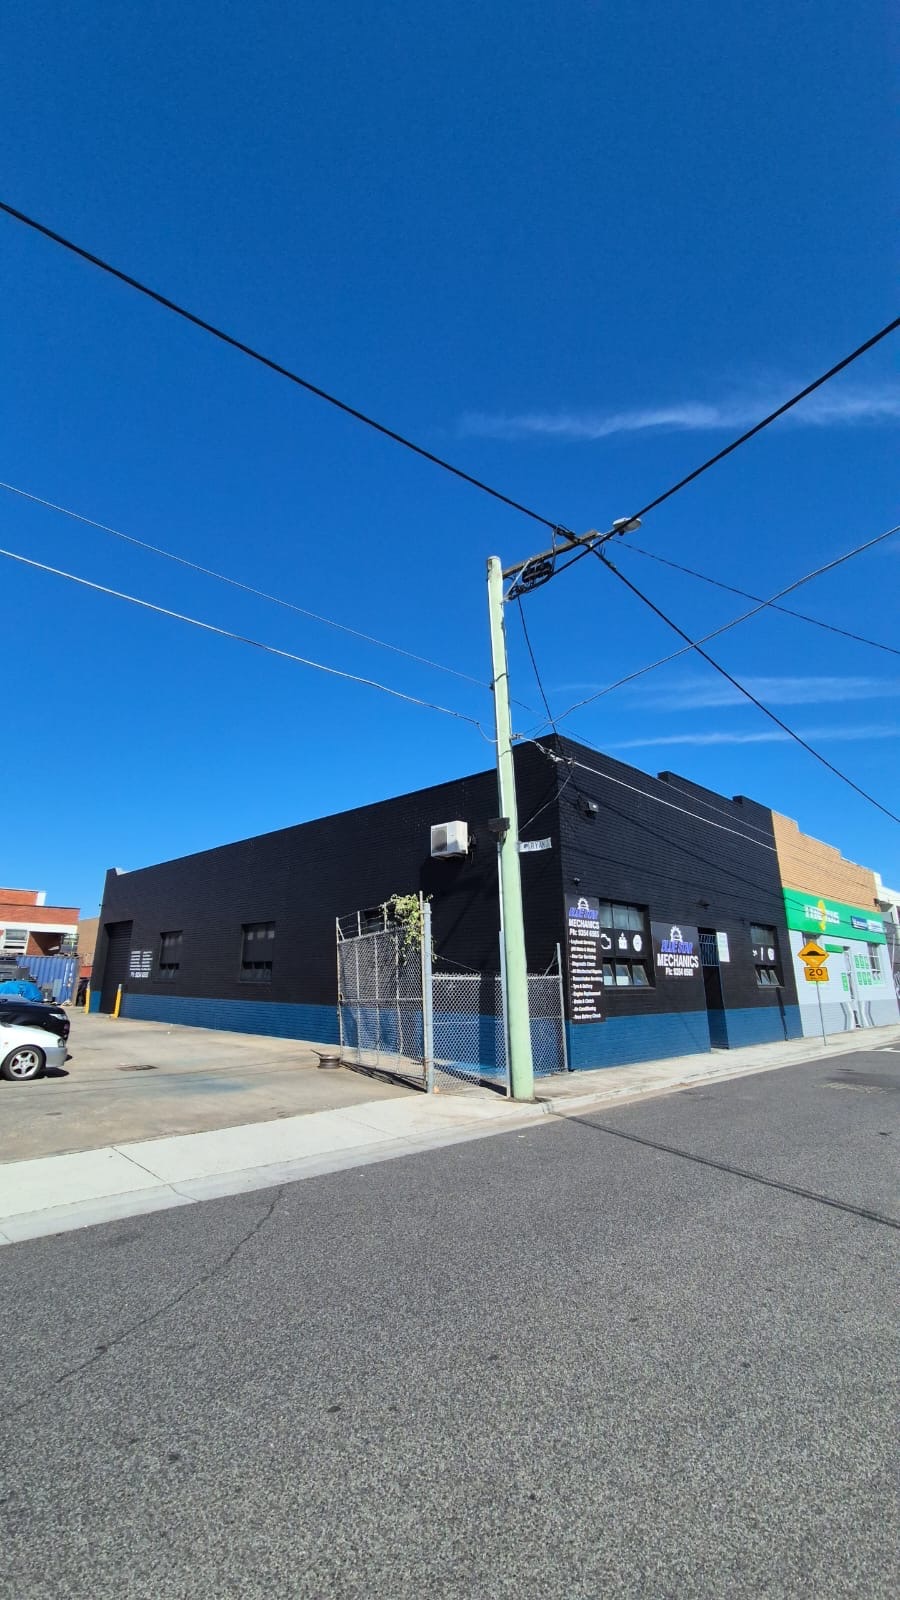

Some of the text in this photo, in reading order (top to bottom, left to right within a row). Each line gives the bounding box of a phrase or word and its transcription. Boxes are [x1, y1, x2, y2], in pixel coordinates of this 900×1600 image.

[569, 918, 600, 930] MECHANICS
[661, 940, 693, 954] BLUE STAR
[657, 953, 699, 968] MECHANICS
[809, 968, 823, 976] 20
